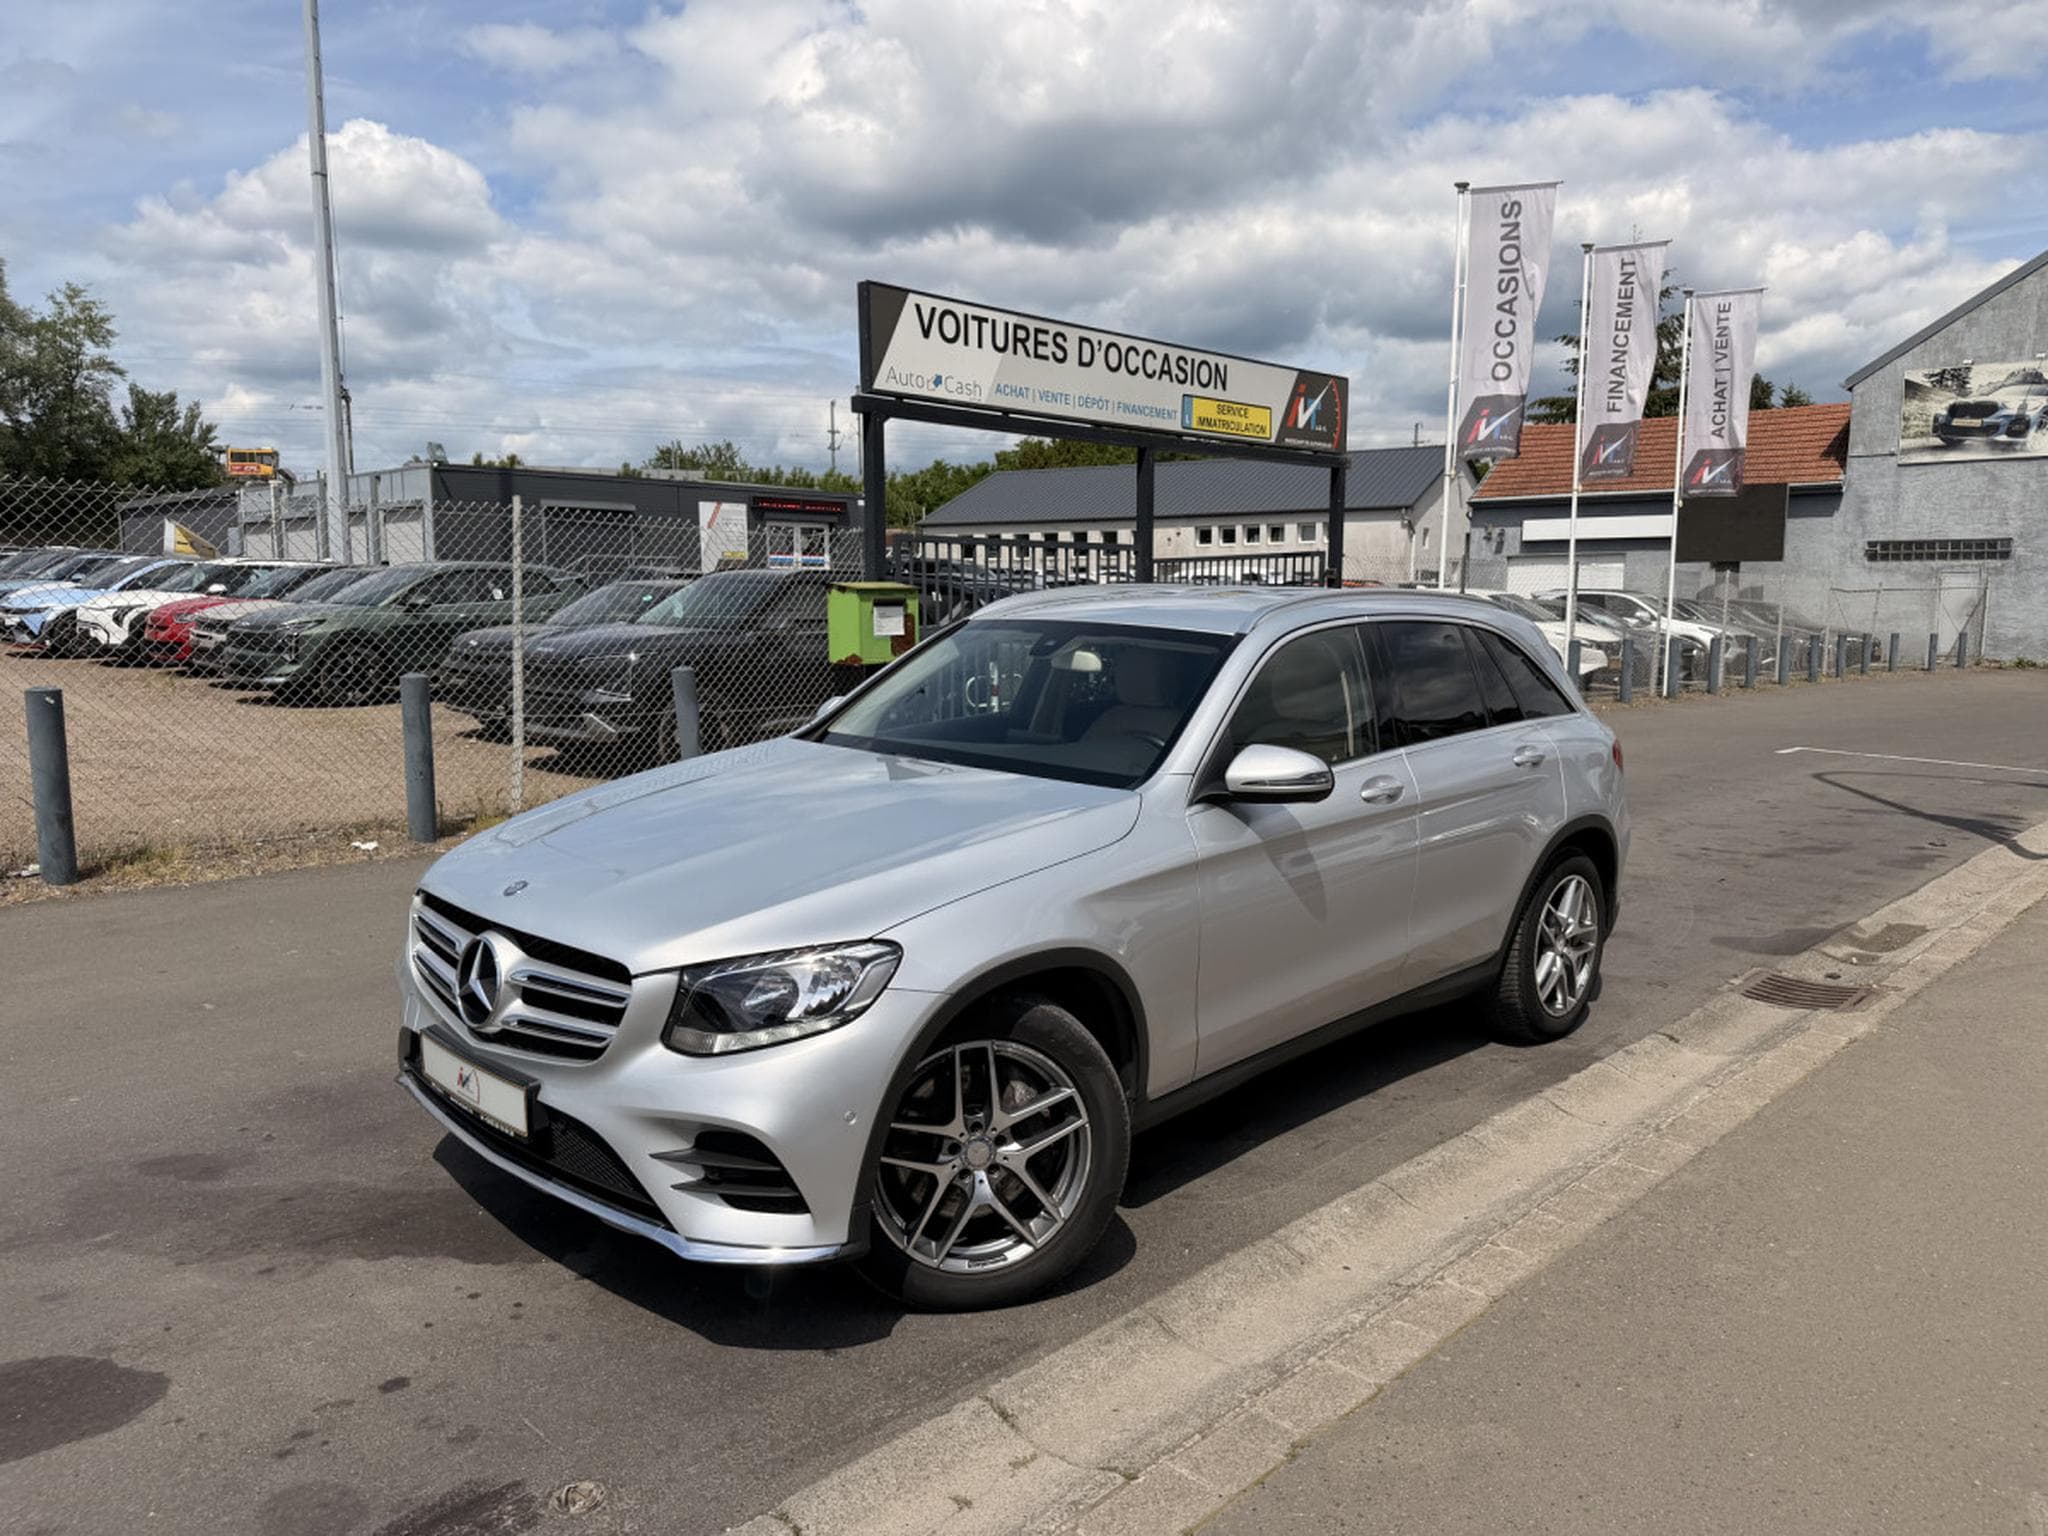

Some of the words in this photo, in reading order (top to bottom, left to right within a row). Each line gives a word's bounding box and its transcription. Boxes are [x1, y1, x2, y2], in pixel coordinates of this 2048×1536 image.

[1491, 200, 1522, 382] OCCASIONS
[914, 303, 1068, 364] VOITURES
[1606, 257, 1637, 413] FINANCEMENT
[1713, 301, 1733, 364] VENTE
[885, 366, 924, 391] Auto
[944, 376, 983, 397] Cash
[994, 384, 1031, 399] ACHAT
[1037, 390, 1071, 405] VENTE
[1078, 394, 1110, 412] DÉPÔT
[1117, 401, 1178, 420] FINANCEMENT
[1216, 403, 1249, 419] SERVICE
[1711, 377, 1731, 440] ACHAT
[1196, 415, 1268, 435] IMMATRICULATION
